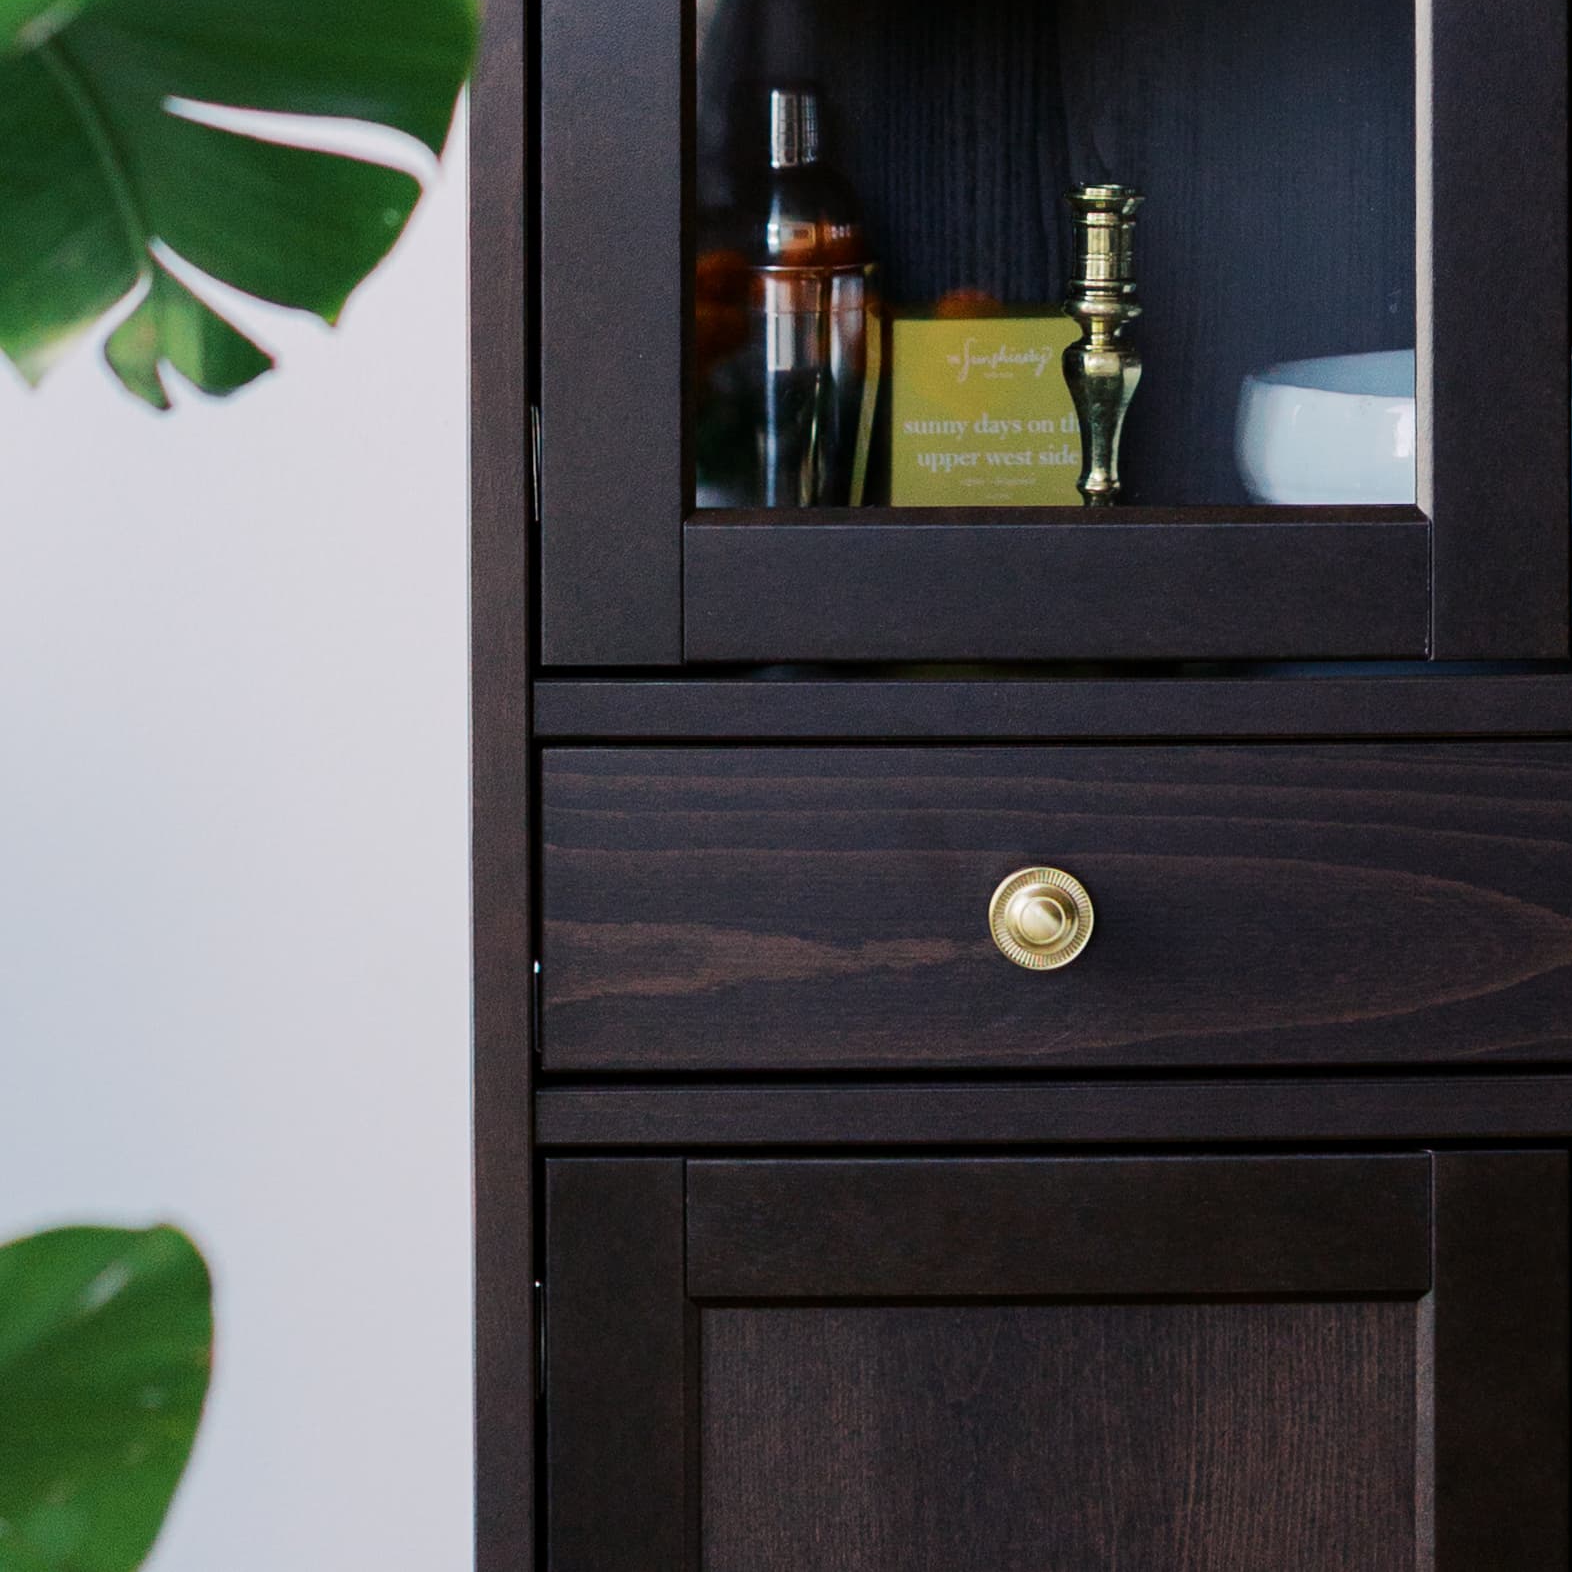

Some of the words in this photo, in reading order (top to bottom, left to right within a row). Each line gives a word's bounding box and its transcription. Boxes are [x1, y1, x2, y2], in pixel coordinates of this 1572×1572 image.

[903, 419, 968, 440] sunny
[972, 412, 1023, 440] days
[1027, 419, 1054, 434] on
[1060, 412, 1082, 434] th
[917, 450, 980, 473] upper
[984, 448, 1033, 466] west
[1038, 443, 1078, 465] side
